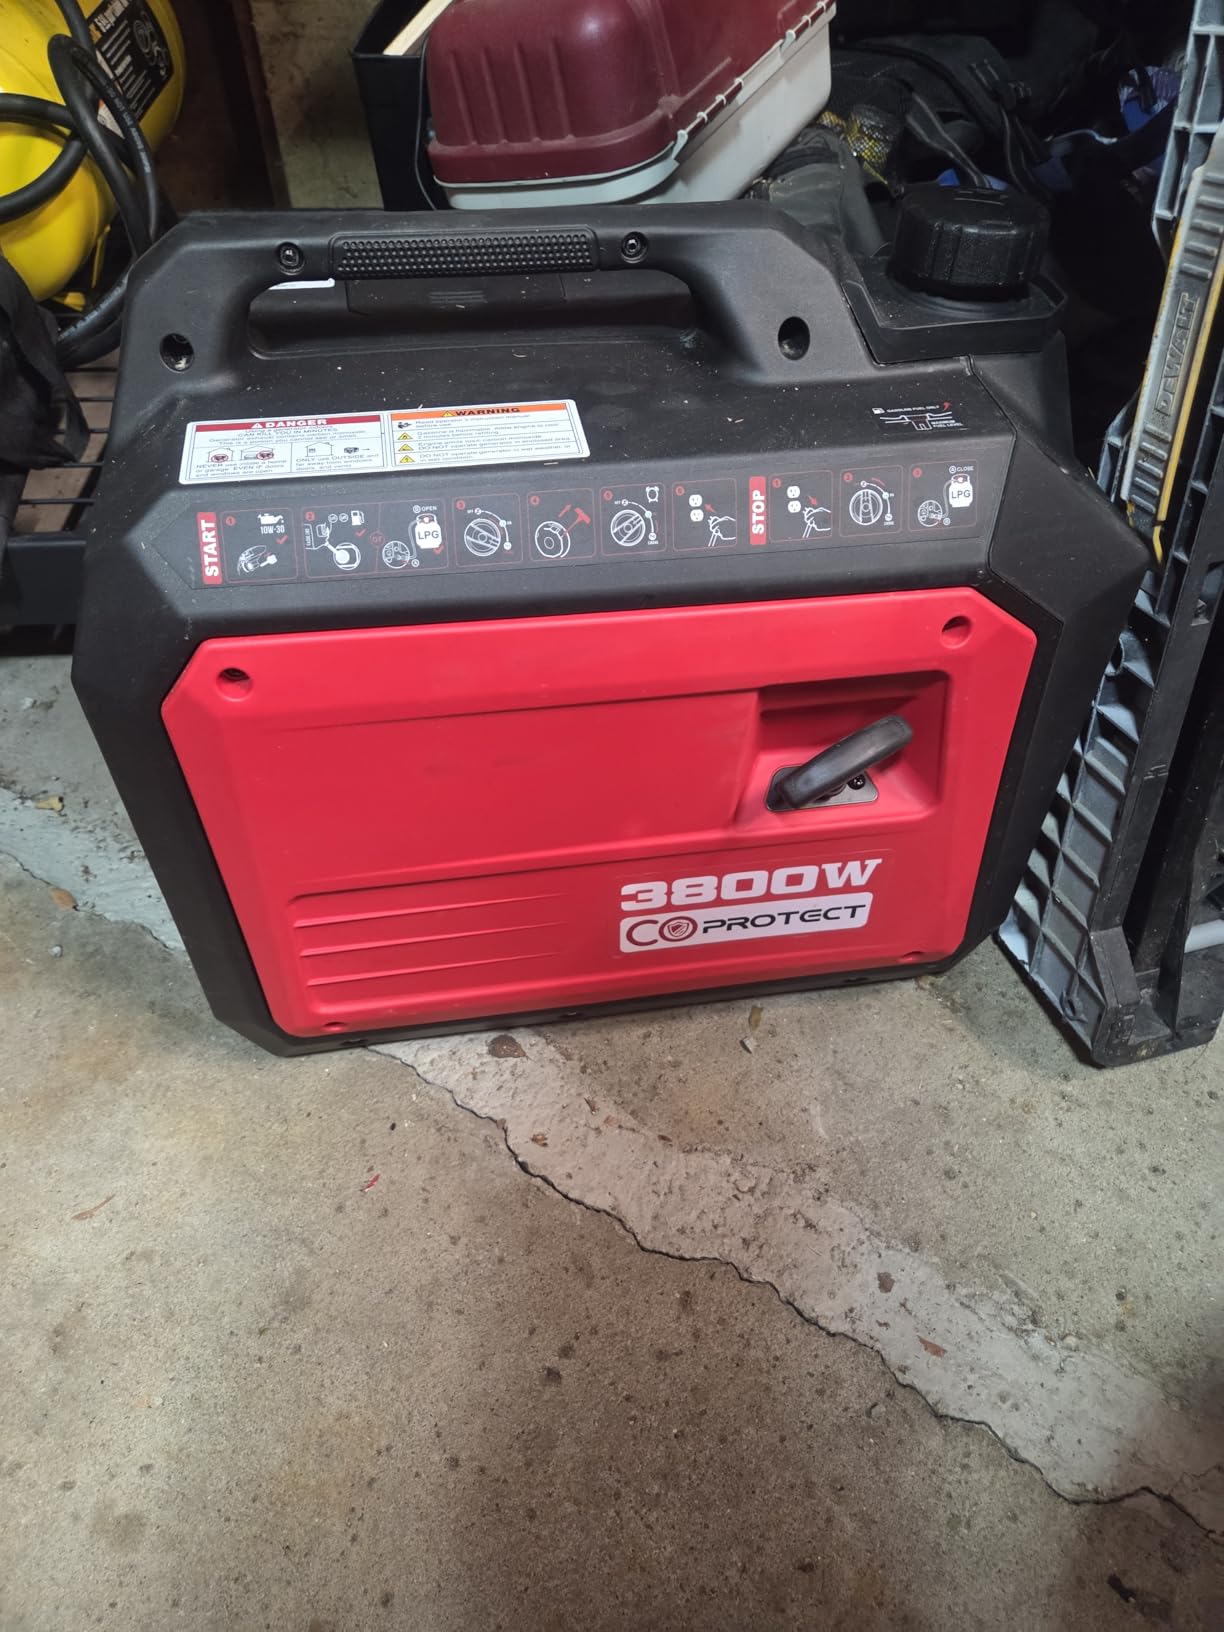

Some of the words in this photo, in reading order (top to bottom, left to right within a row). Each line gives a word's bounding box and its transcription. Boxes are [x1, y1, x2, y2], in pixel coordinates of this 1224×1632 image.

[455, 407, 520, 416] WARNING
[265, 418, 327, 428] DANGER
[951, 489, 972, 500] LPG
[421, 505, 438, 513] OPEN
[752, 489, 765, 535] STOP
[259, 524, 285, 535] 10W-30
[417, 529, 440, 541] LPG
[201, 519, 219, 577] START
[620, 857, 883, 912] 3800W
[625, 915, 699, 947] CO
[702, 904, 866, 934] PROTECT
